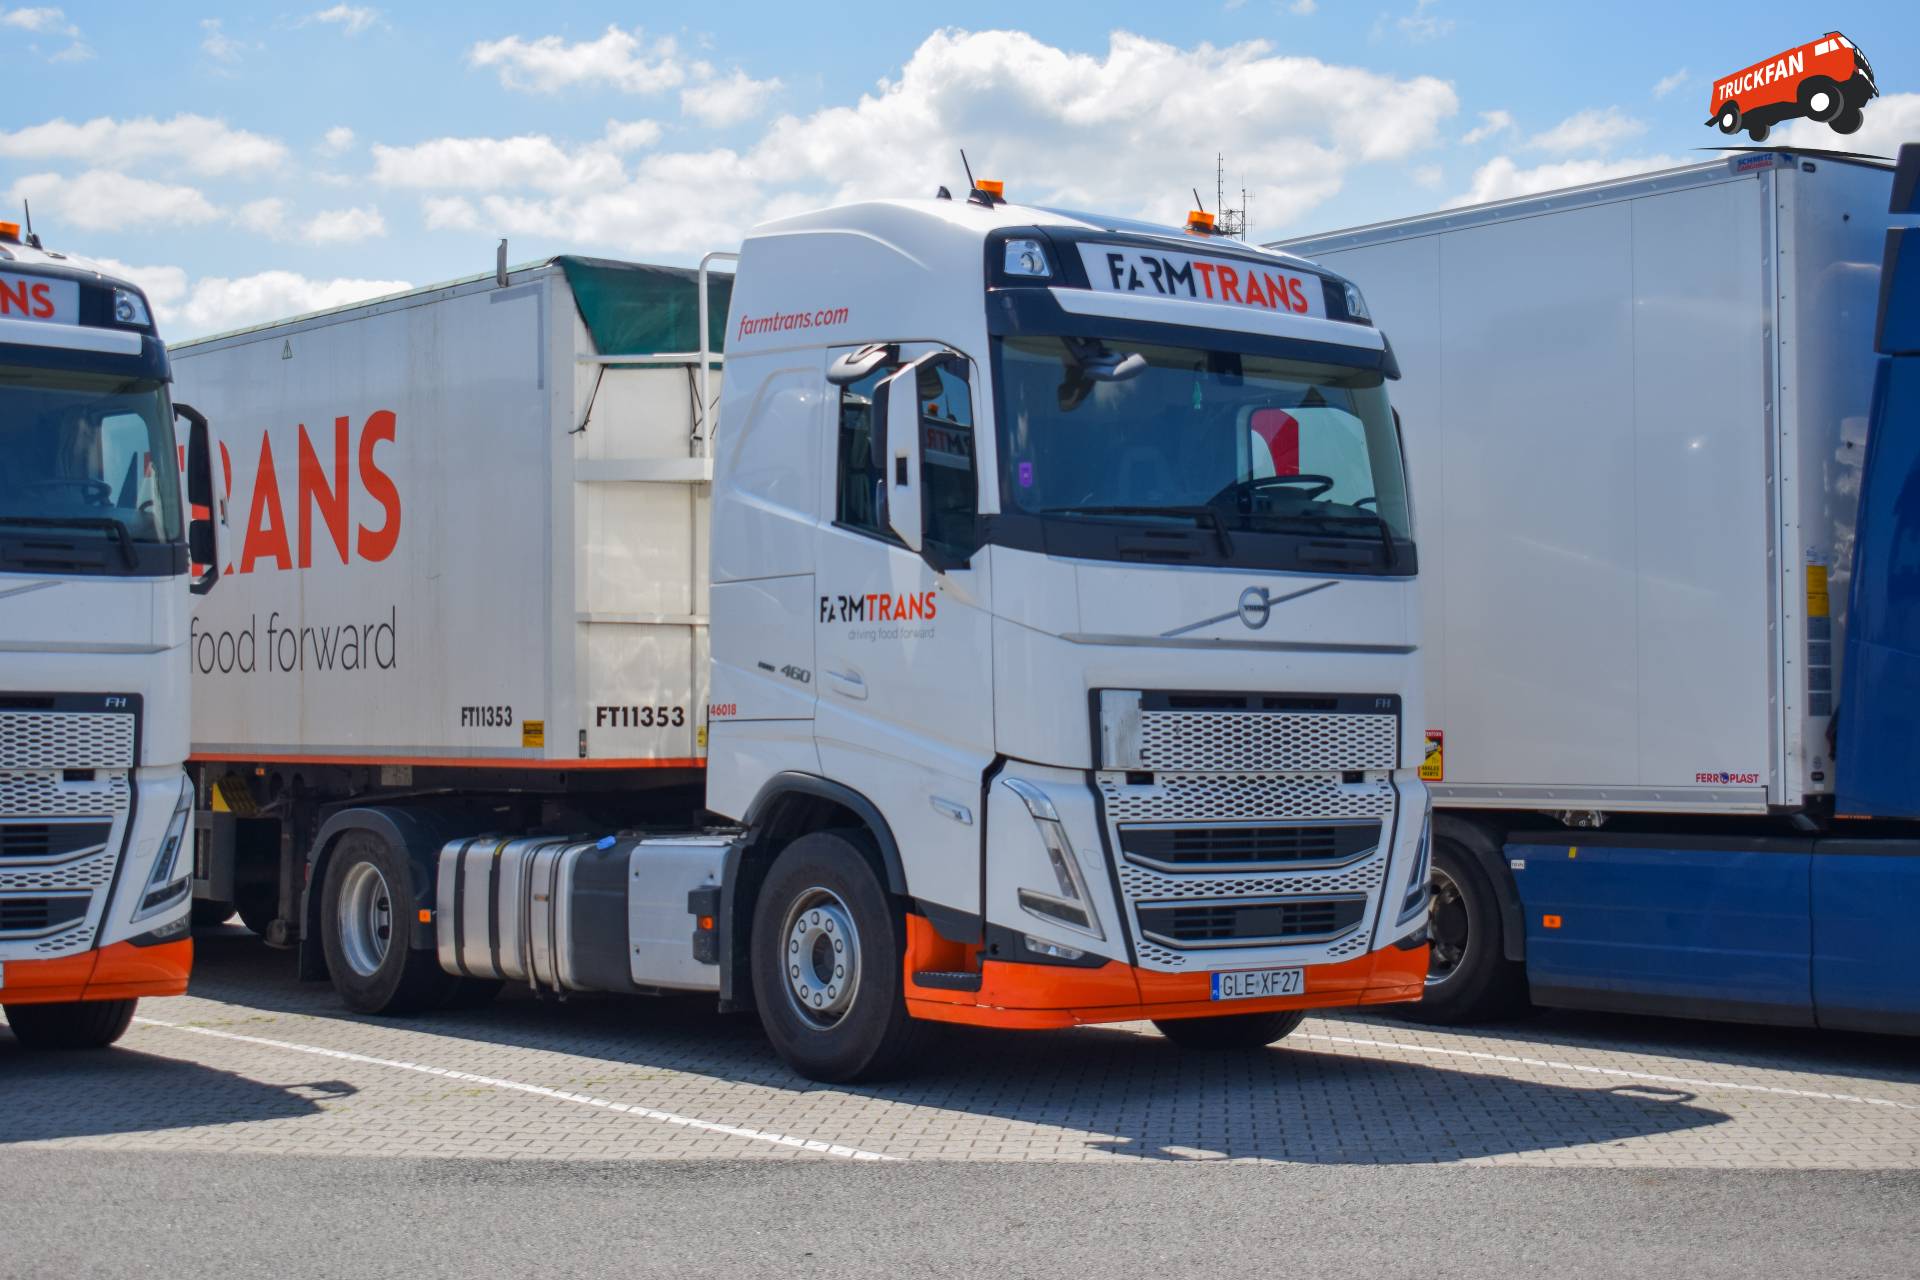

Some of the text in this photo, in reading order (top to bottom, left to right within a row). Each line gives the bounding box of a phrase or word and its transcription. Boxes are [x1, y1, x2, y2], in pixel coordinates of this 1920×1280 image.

[1106, 252, 1309, 314] FARMTRANS
[738, 307, 849, 342] farmtrans.com
[820, 592, 937, 623] FARMTRANS
[190, 605, 397, 674] food forward
[848, 628, 876, 643] driving
[879, 627, 898, 639] food
[780, 664, 811, 683] 460
[105, 697, 127, 707] FH
[711, 704, 737, 716] 46018
[1375, 698, 1392, 708] FH
[461, 706, 512, 727] FT11353
[597, 706, 685, 727] FT11353
[1223, 974, 1255, 996] GLE
[1261, 971, 1300, 994] XF27
